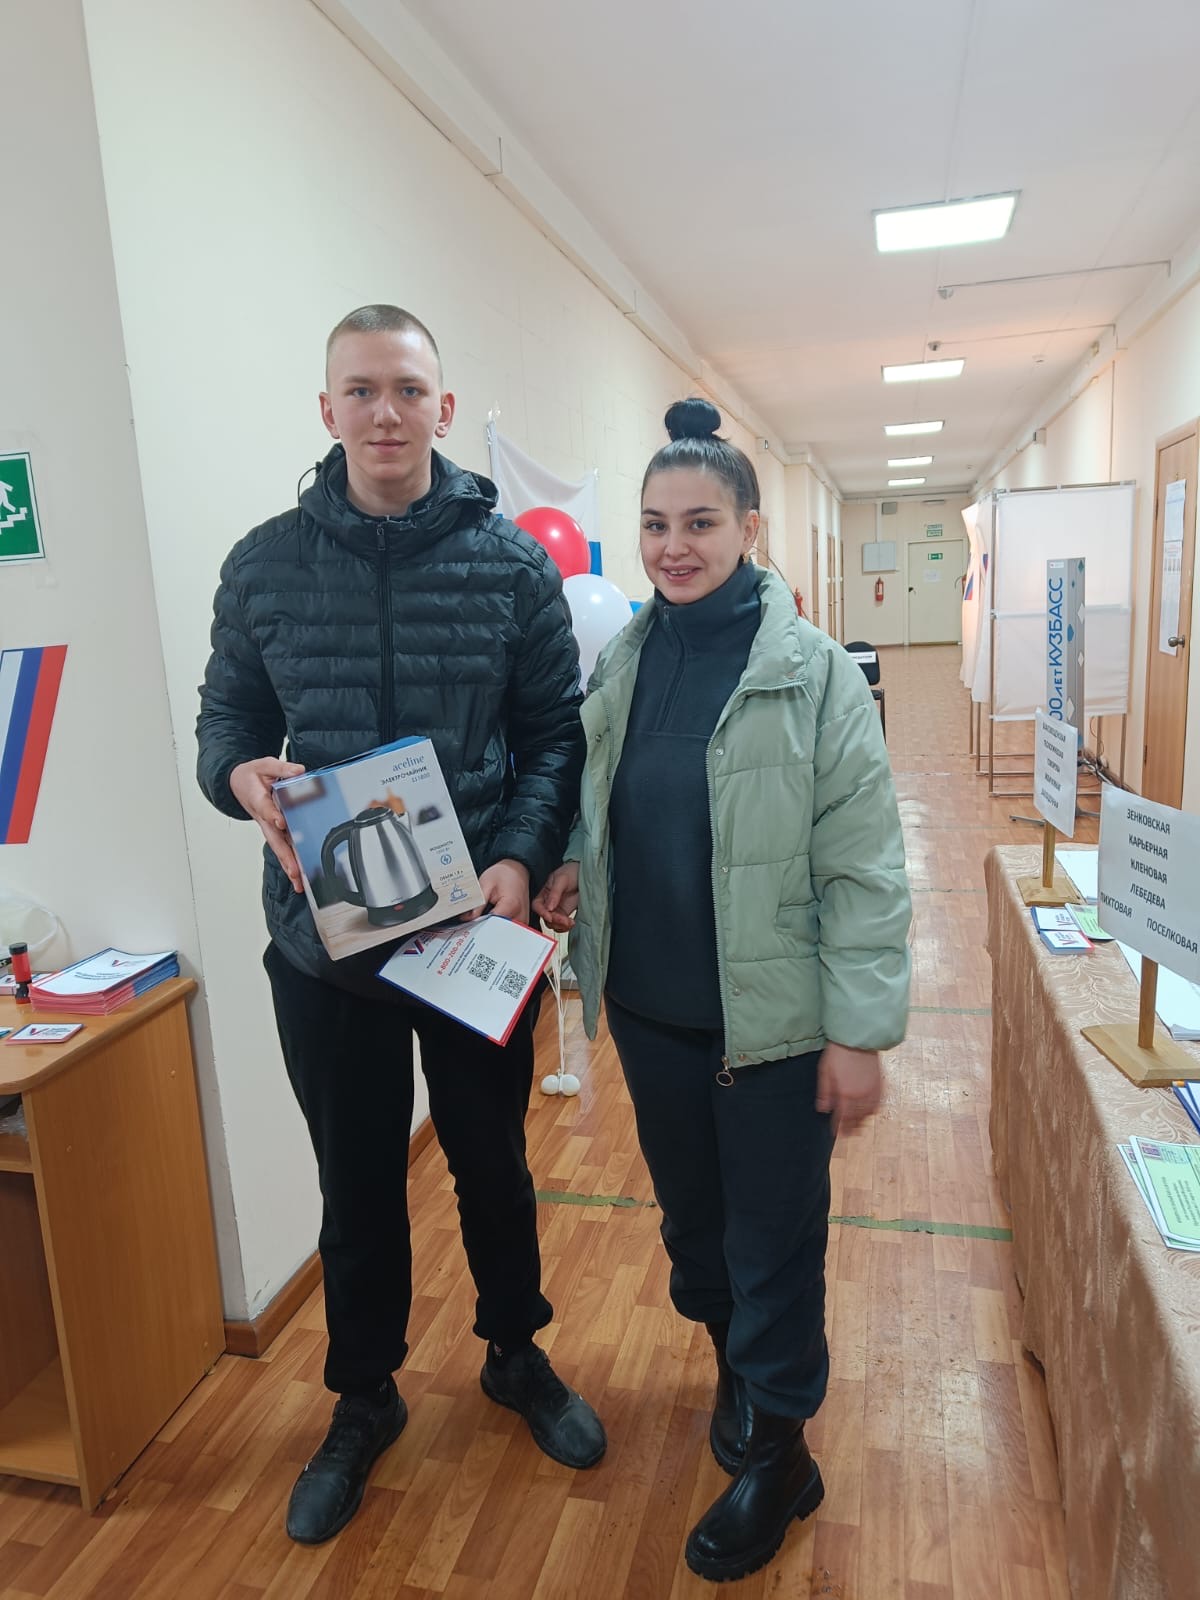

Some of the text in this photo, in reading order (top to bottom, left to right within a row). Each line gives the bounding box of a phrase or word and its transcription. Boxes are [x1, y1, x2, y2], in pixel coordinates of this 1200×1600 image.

[1048, 577, 1063, 667] КУЗБАСС
[381, 766, 427, 785] ЭЛЕКТРОЧАЙНИК
[392, 754, 425, 772] aceline
[1127, 808, 1171, 835] ЗЕНКОВСКАЯ
[1128, 833, 1169, 861] КАРЬЕРНАЯ
[1130, 858, 1168, 885] КЛЕНОВАЯ
[1130, 883, 1166, 911] ЛЕБЕДЕВА
[1146, 917, 1199, 954] ПОСЕЛКОВАЯ
